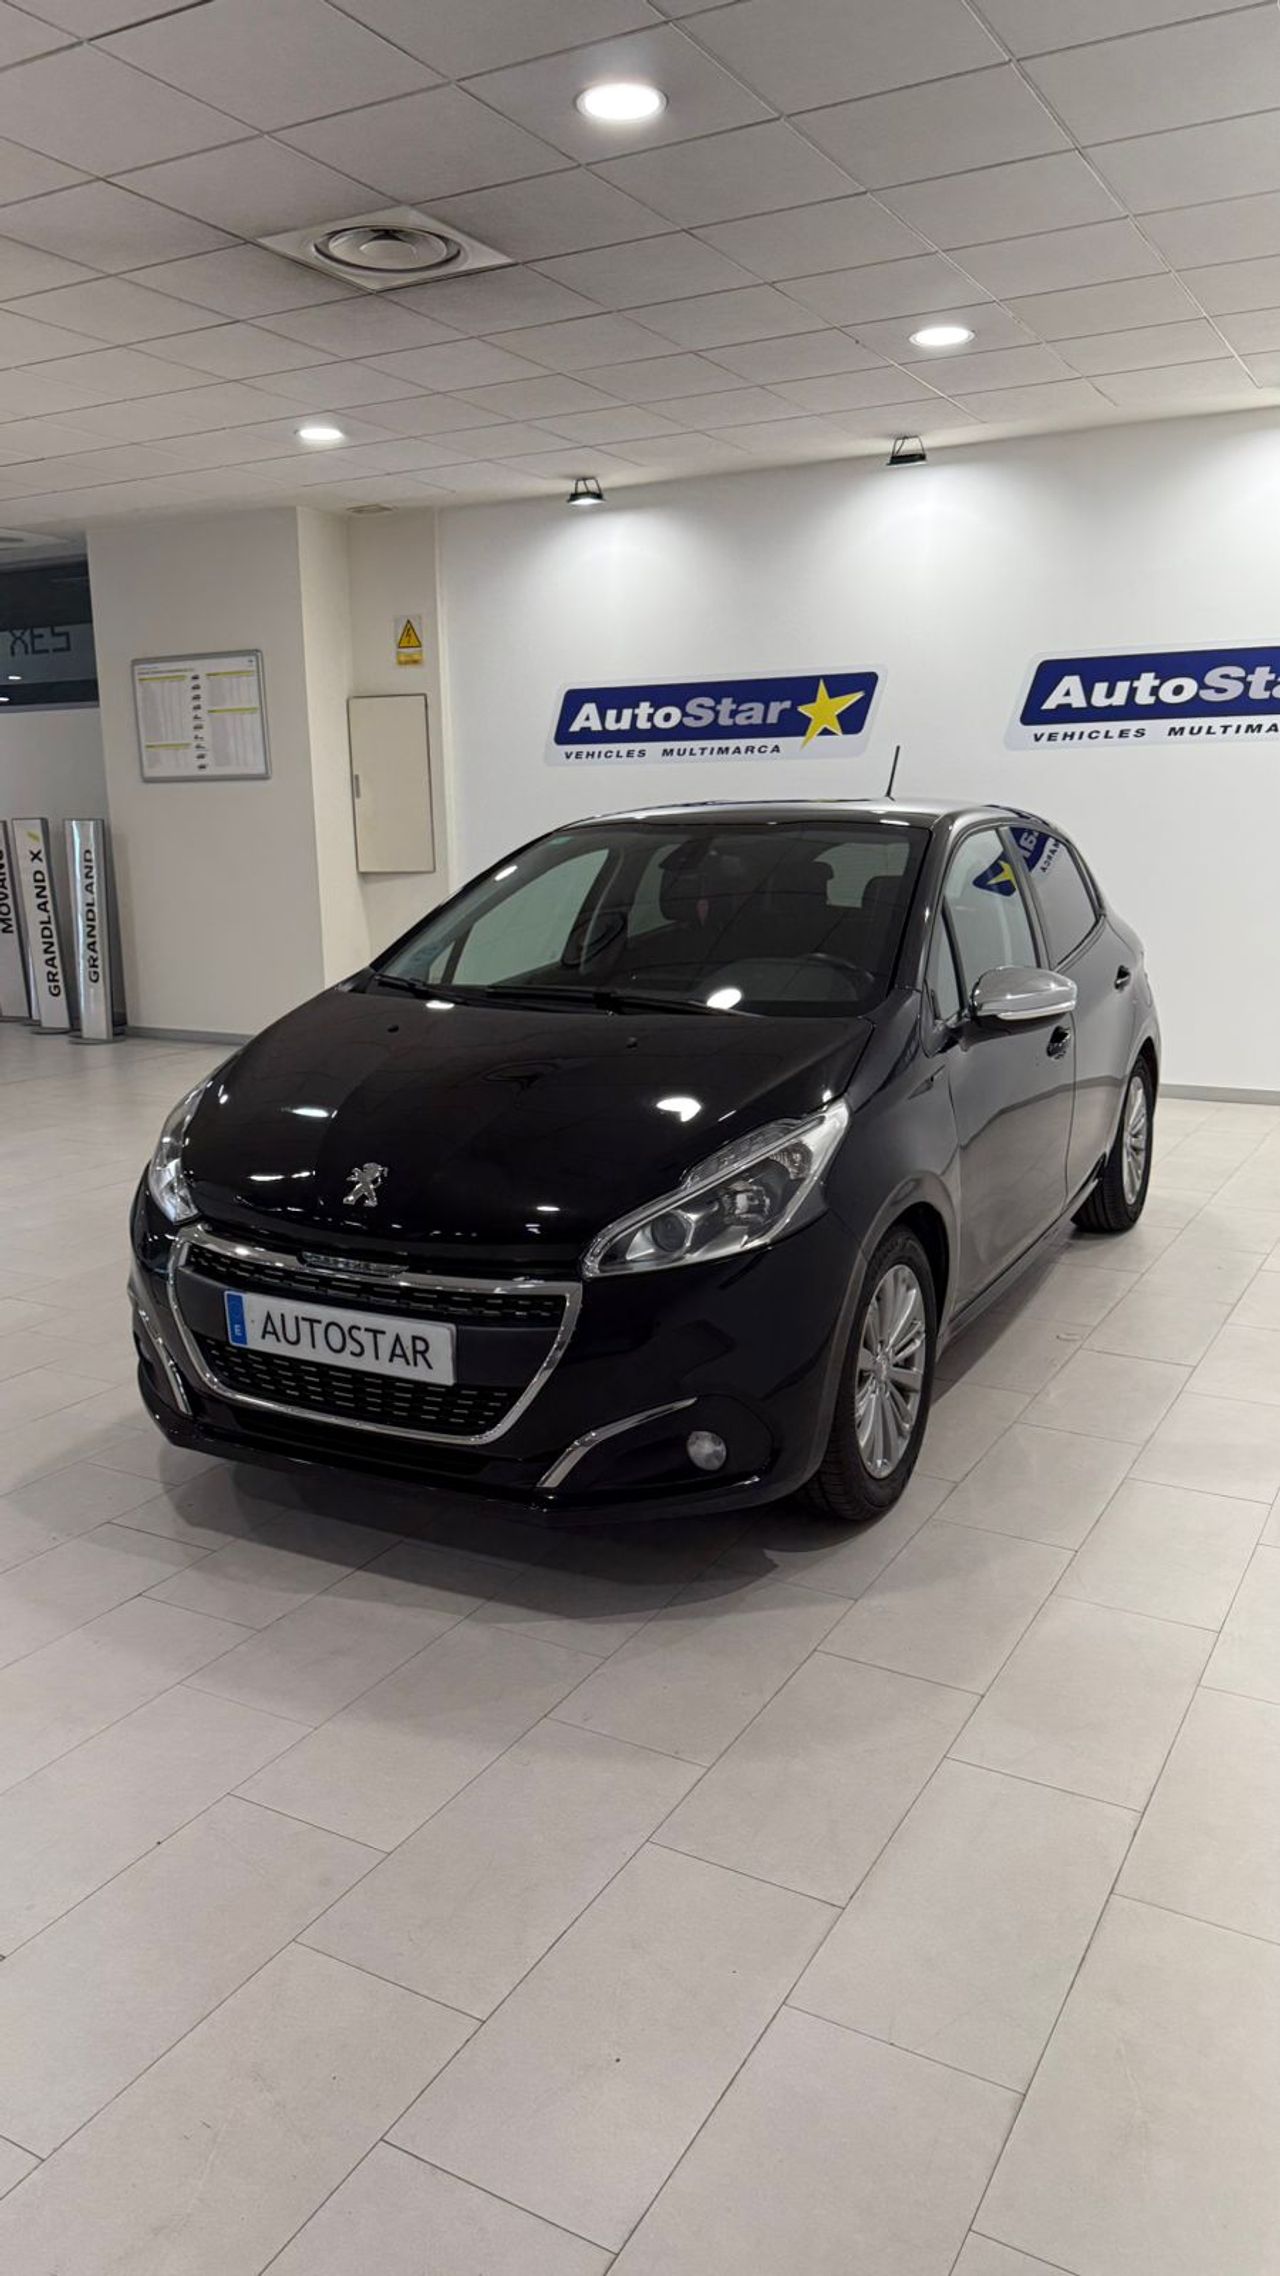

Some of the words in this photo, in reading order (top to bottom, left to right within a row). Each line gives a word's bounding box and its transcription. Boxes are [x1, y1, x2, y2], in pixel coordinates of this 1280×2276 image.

[568, 696, 792, 733] AutoStar
[1033, 728, 1147, 743] VEHICLES
[564, 749, 647, 760] VEHICLES
[661, 744, 782, 757] MULTIMARCA
[29, 849, 43, 863] X
[83, 849, 100, 984] GRANDLAND
[32, 869, 62, 997] GRANDLAND
[233, 1324, 243, 1336] E
[261, 1310, 434, 1370] AUTOSTAR
